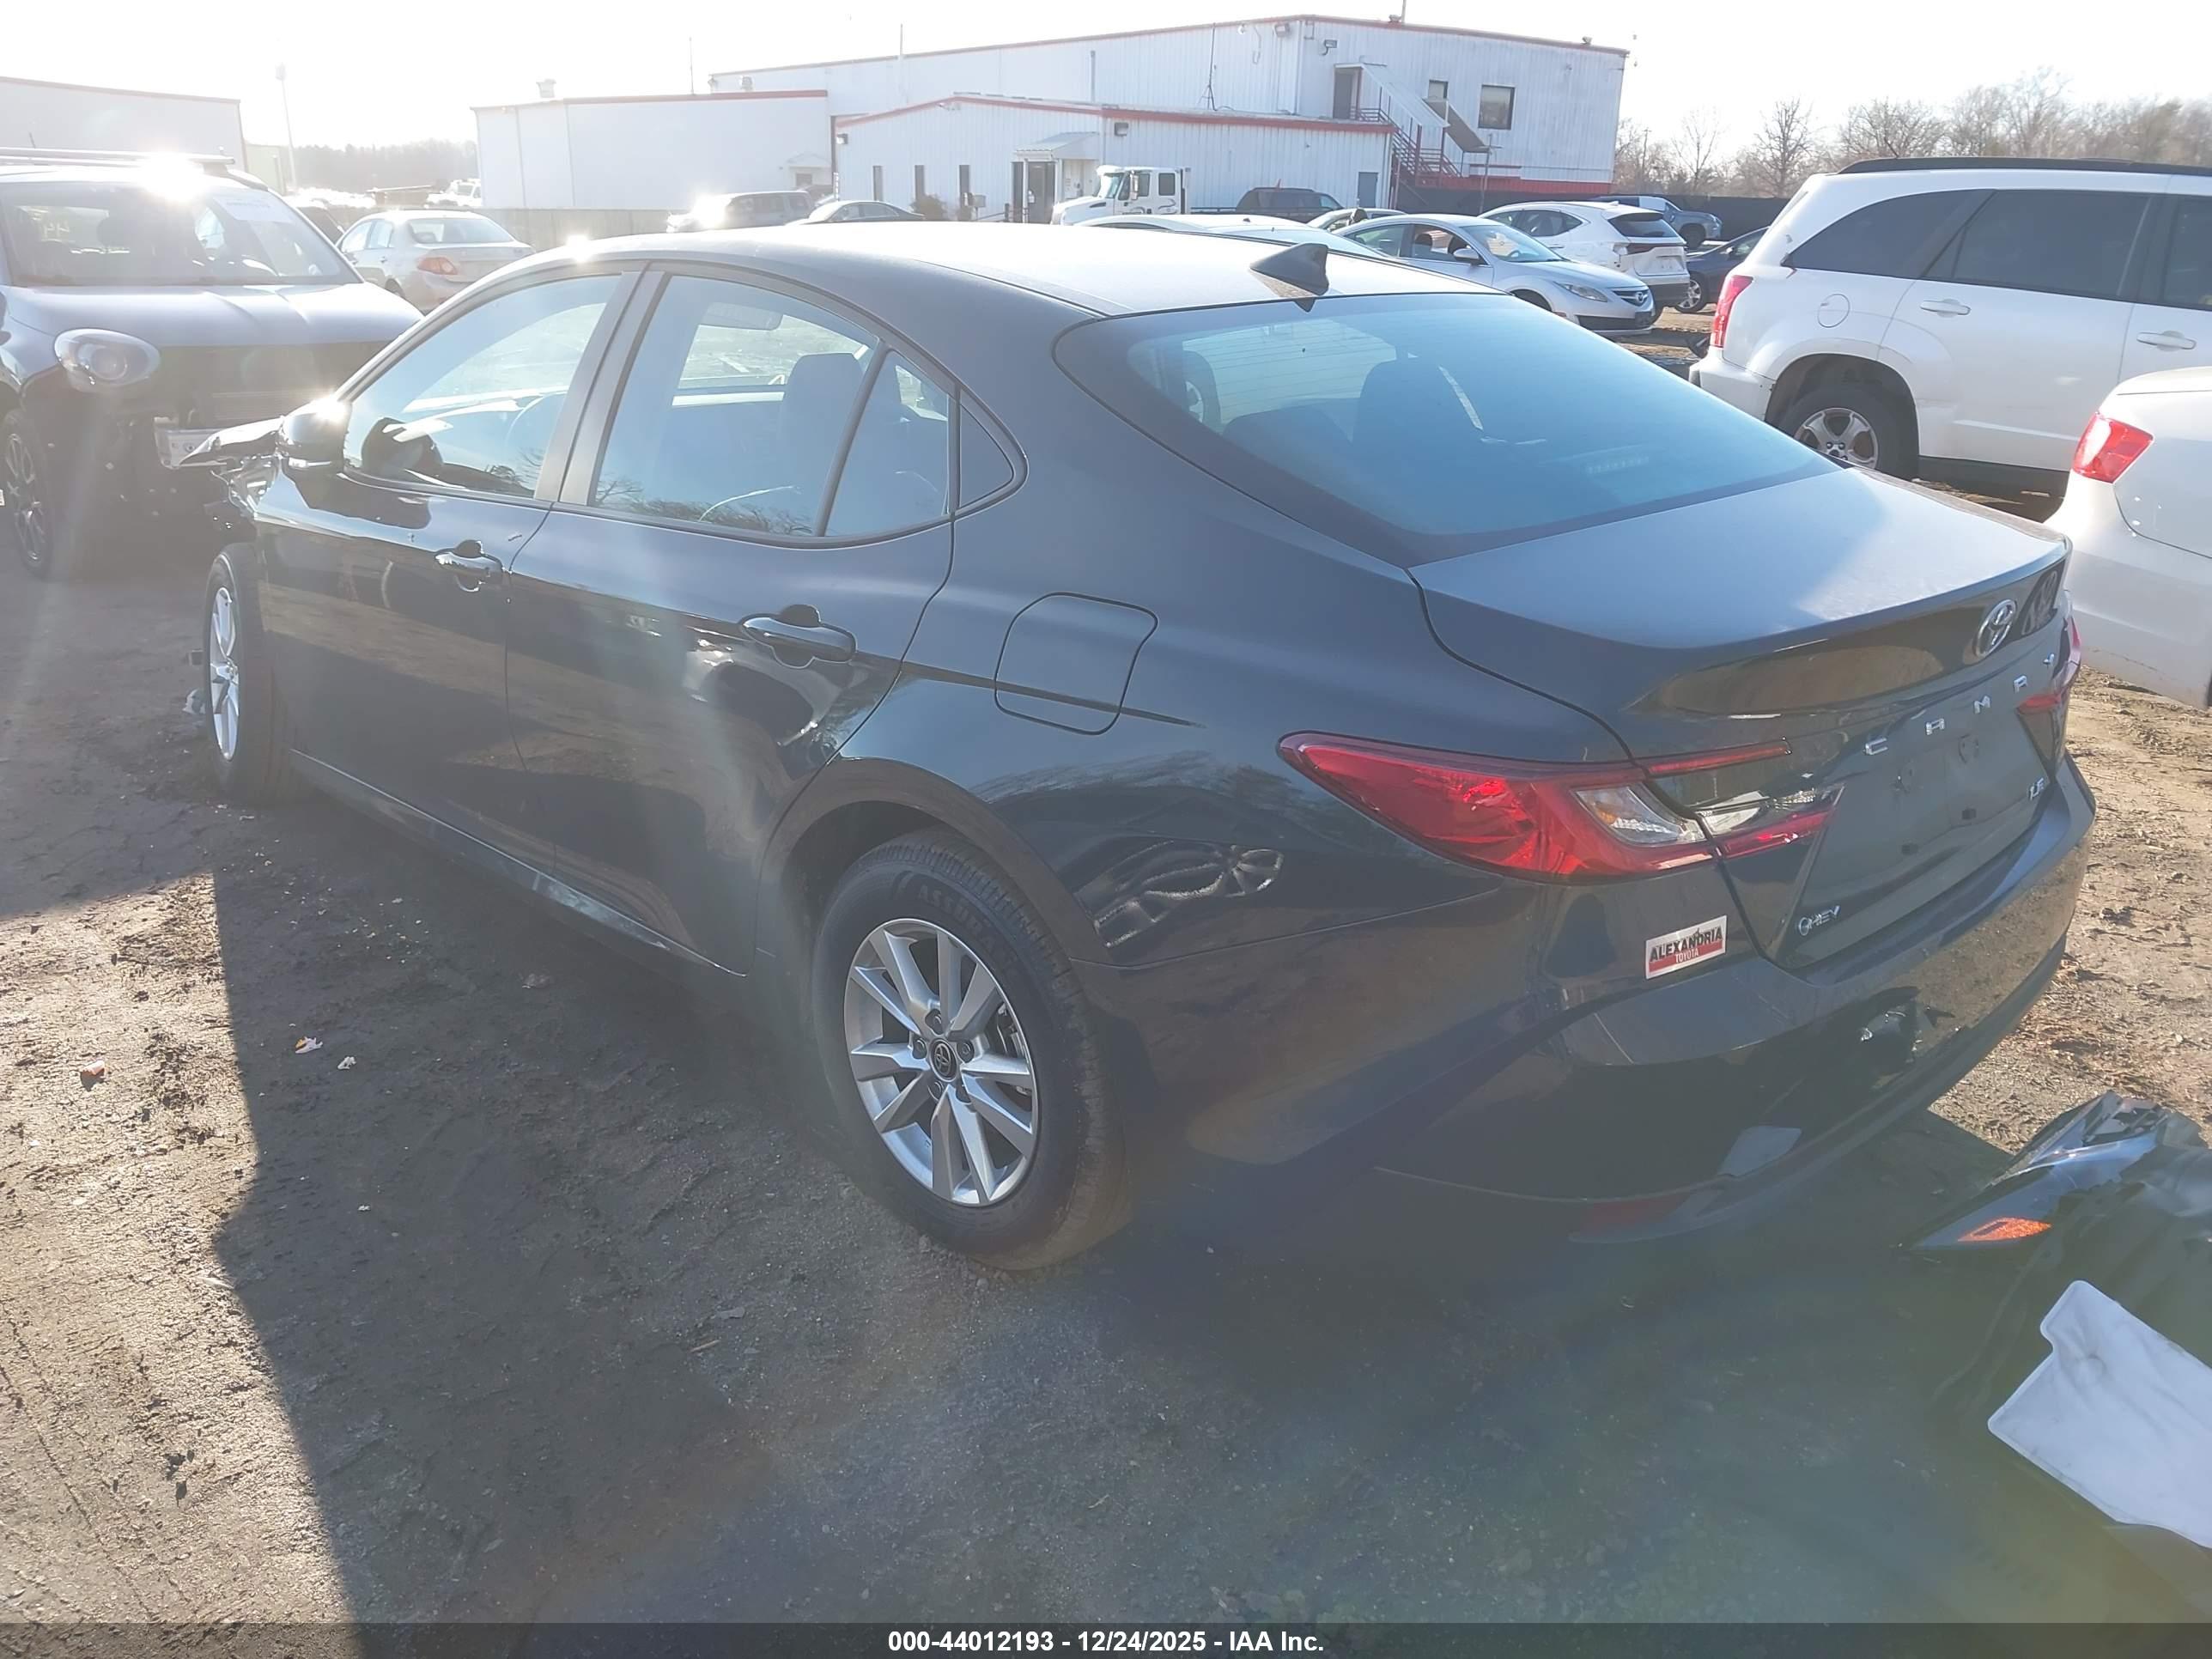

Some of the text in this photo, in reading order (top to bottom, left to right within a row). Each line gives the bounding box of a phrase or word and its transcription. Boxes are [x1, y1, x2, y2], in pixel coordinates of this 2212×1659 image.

[1863, 653, 2055, 756] CAMRY
[1650, 925, 1724, 963] ALEXANDRIA
[1675, 947, 1699, 963] TOYOTA
